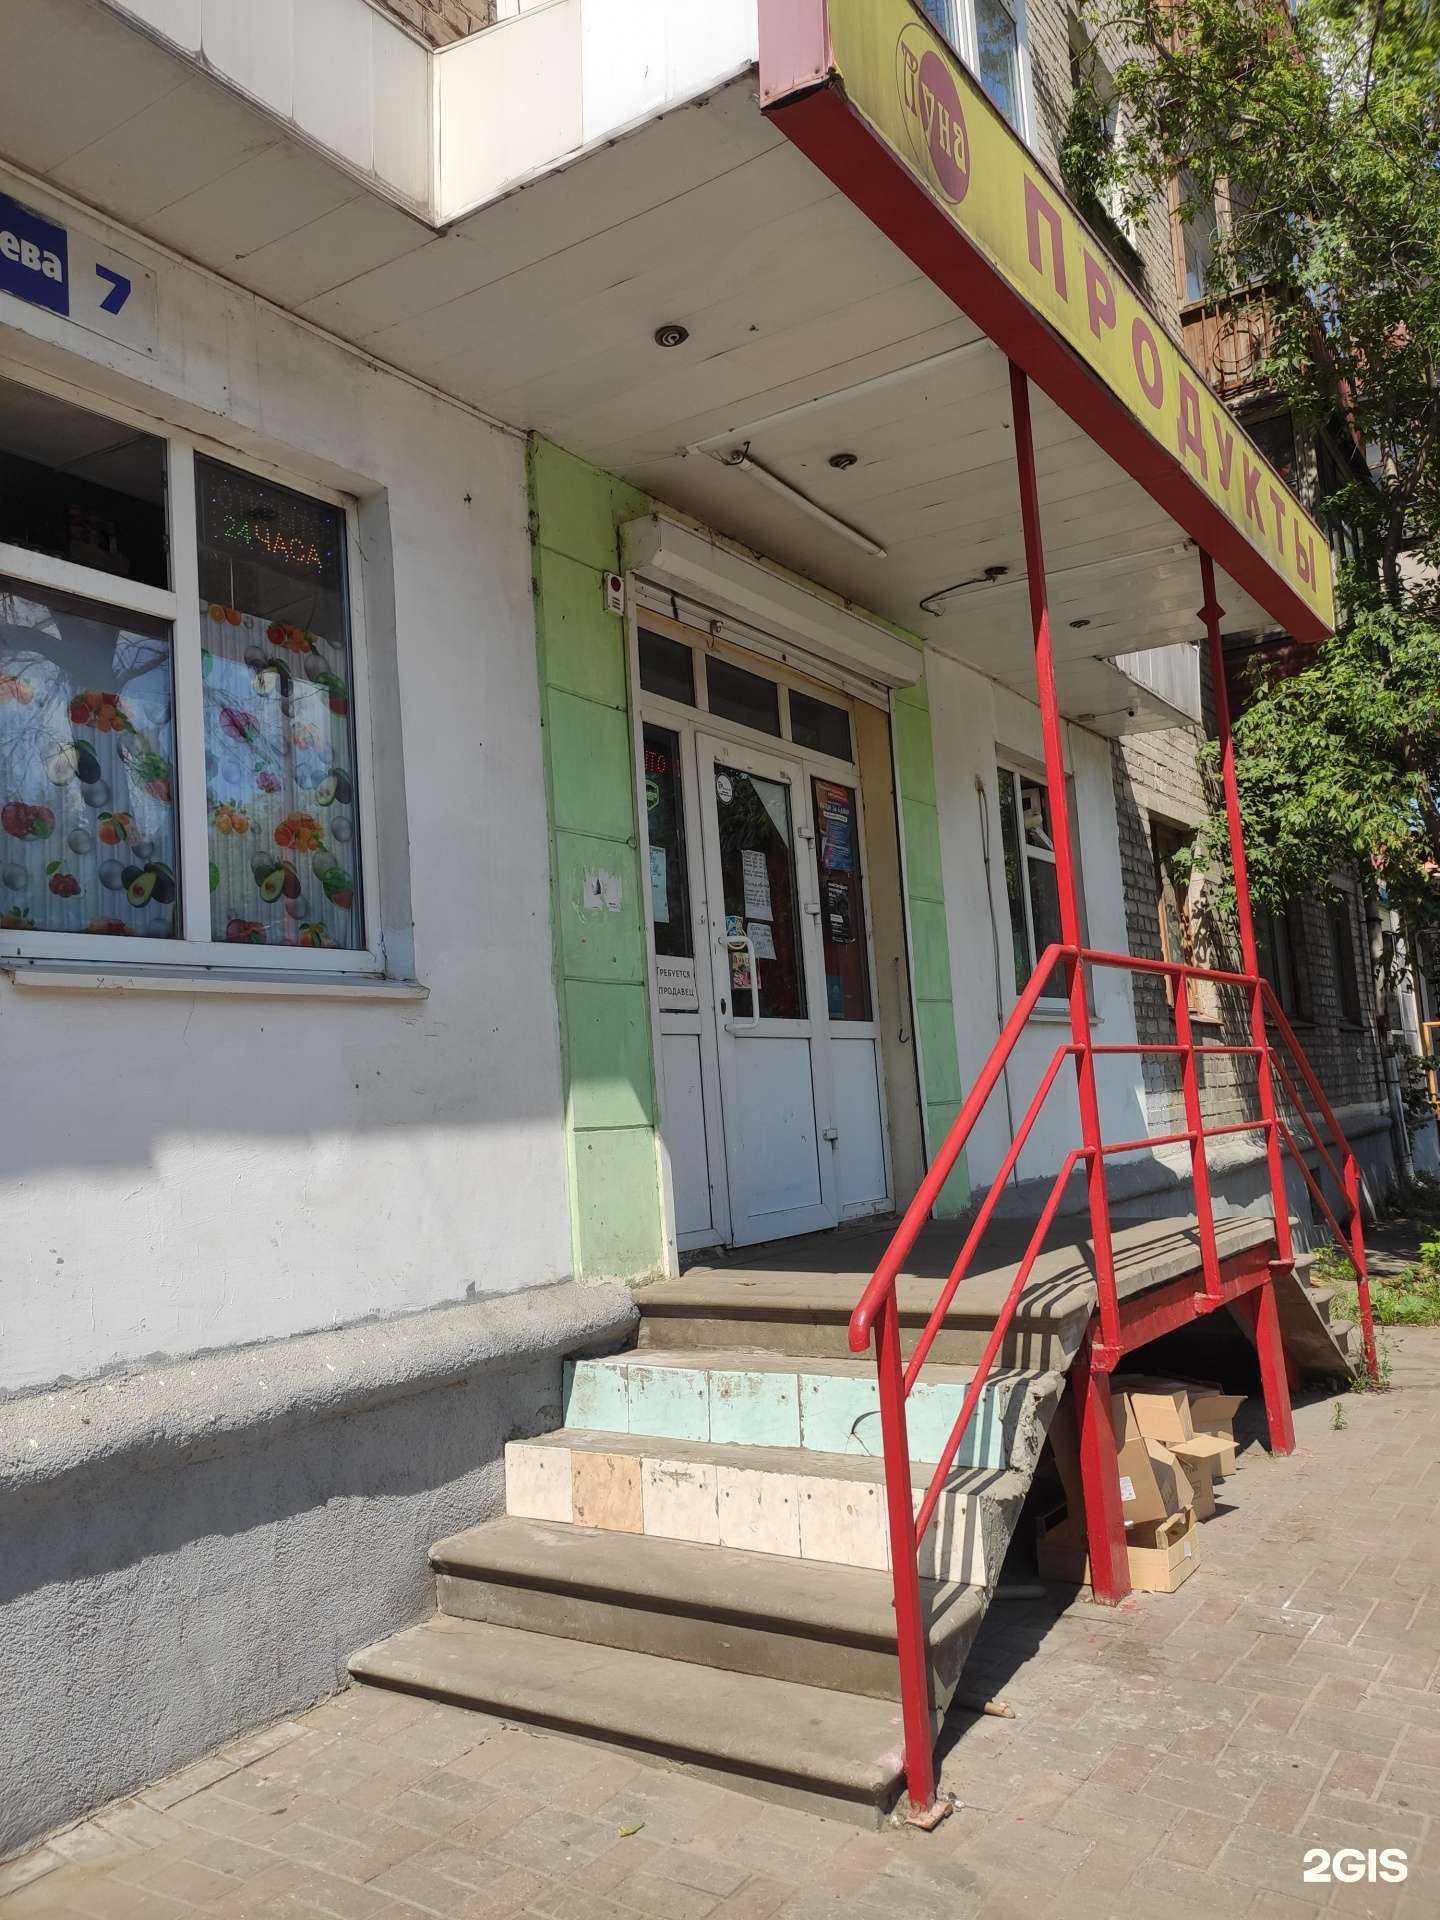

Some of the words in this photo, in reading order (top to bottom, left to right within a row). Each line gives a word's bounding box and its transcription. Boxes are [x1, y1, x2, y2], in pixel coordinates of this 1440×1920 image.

[96, 262, 132, 315] 7
[1024, 173, 1317, 593] ПРОДУКТЫ
[223, 514, 252, 545] 24
[254, 524, 323, 570] ЧАСА
[658, 986, 695, 998] ПРОДАВЕЦ
